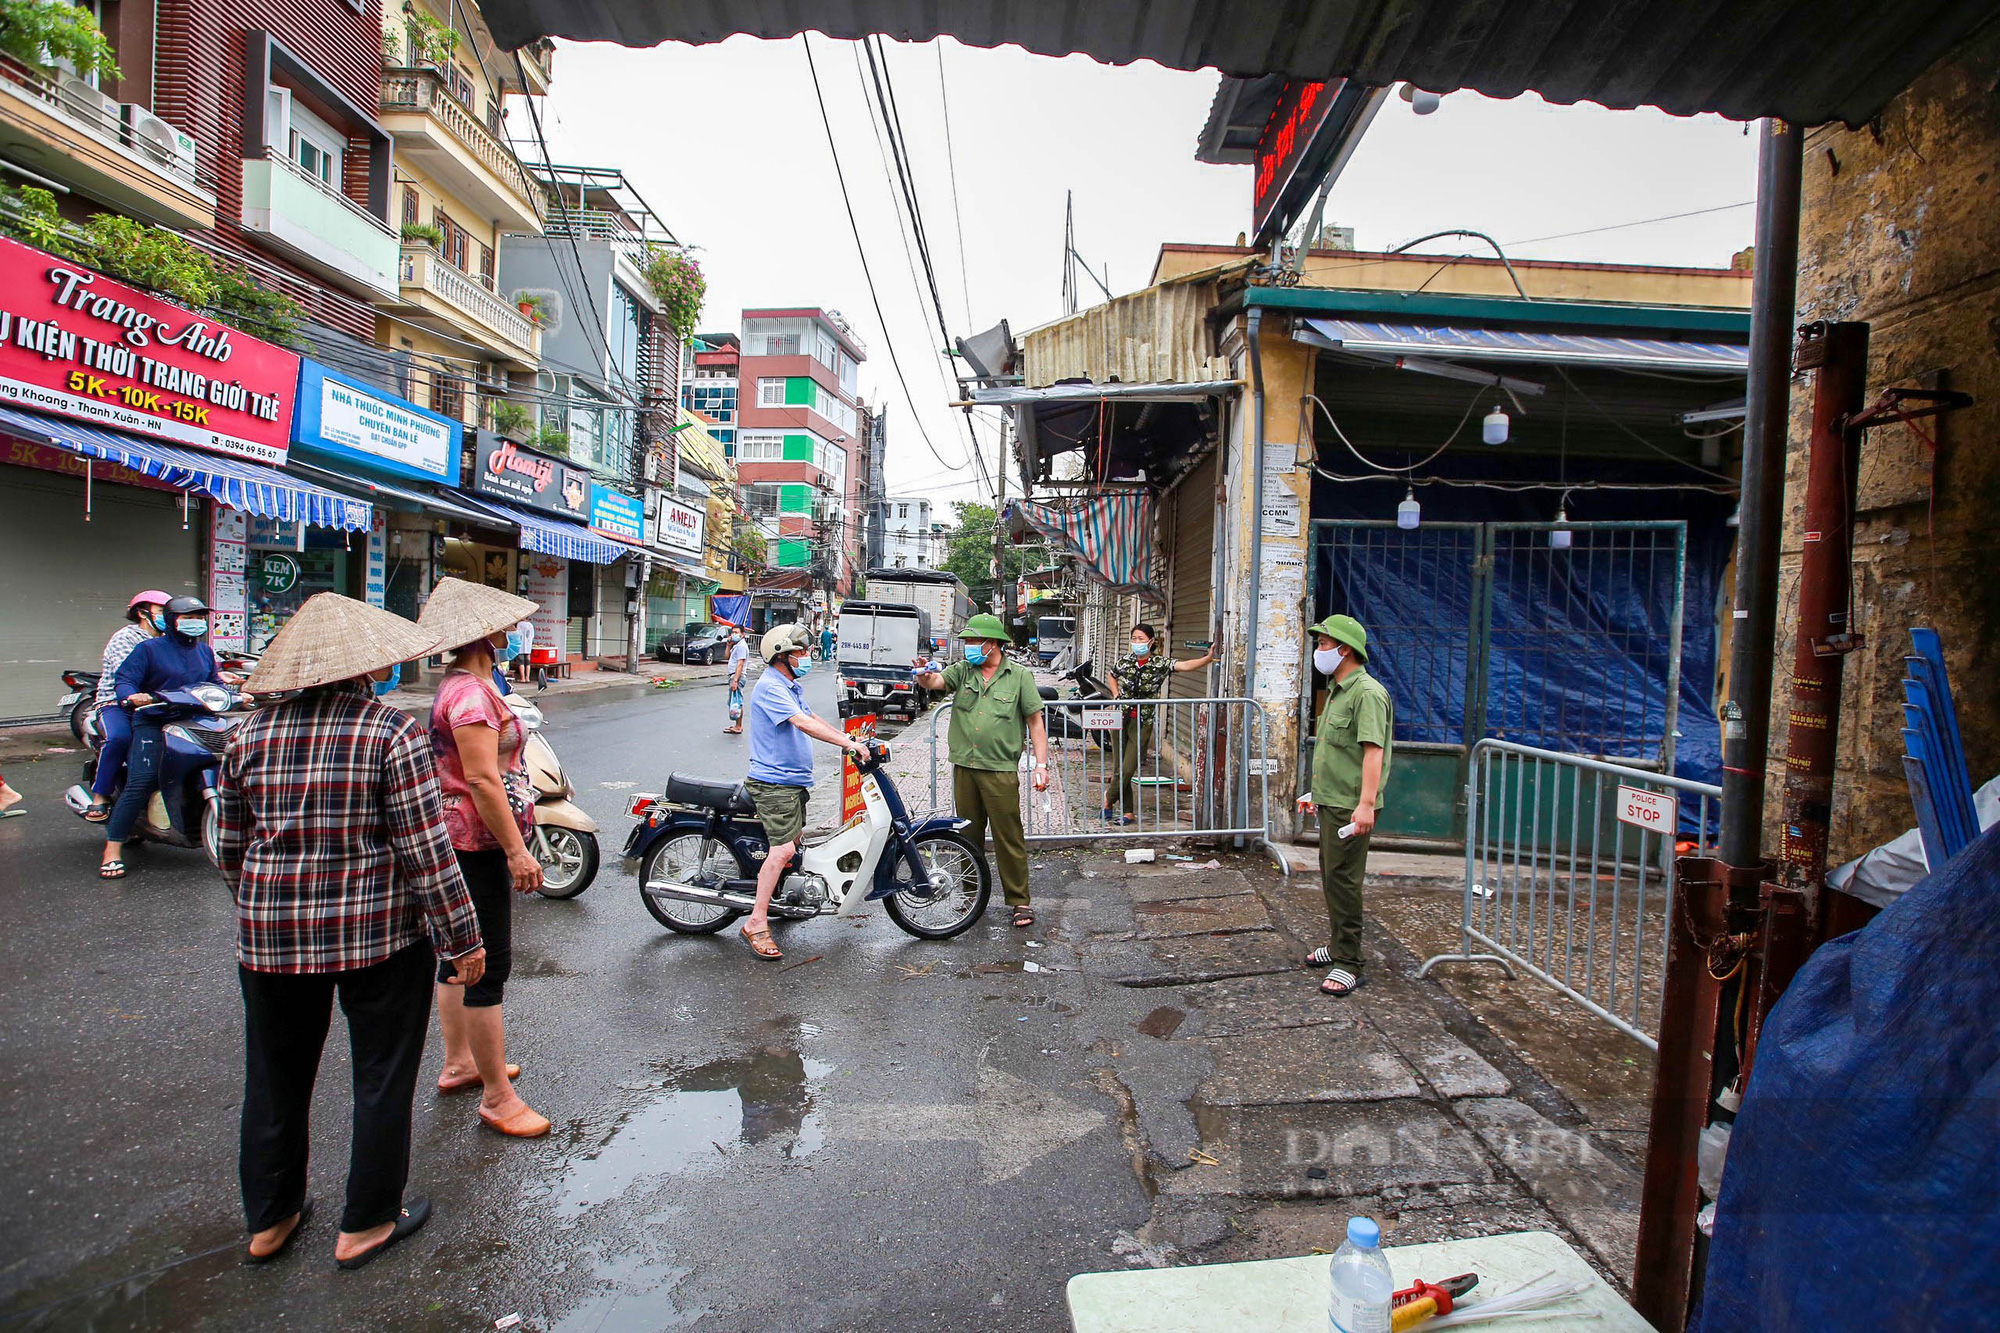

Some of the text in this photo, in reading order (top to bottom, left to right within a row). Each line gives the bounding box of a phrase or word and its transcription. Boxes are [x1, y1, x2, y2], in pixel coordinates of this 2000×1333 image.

[51, 268, 233, 363] Trang Anh
[17, 316, 76, 361] KIỆN
[82, 337, 137, 379] THỜI
[142, 356, 206, 400] TRANG
[209, 379, 247, 412] GIỚI
[251, 392, 281, 422] TRẺ
[22, 387, 68, 409] Khoang
[78, 401, 110, 418] Thanh
[112, 410, 139, 425] Xuân
[147, 419, 162, 431] HN
[332, 389, 352, 407] NHÀ
[355, 397, 384, 417] THUỐC
[386, 409, 408, 427] MINH
[9, 442, 40, 464] 5K
[225, 438, 277, 459] 0394 69 55 67
[669, 508, 698, 529] AMELY
[263, 559, 290, 575] KEM
[265, 575, 285, 588] 7K
[1631, 793, 1657, 806] POLICE
[1627, 804, 1661, 822] STOP
